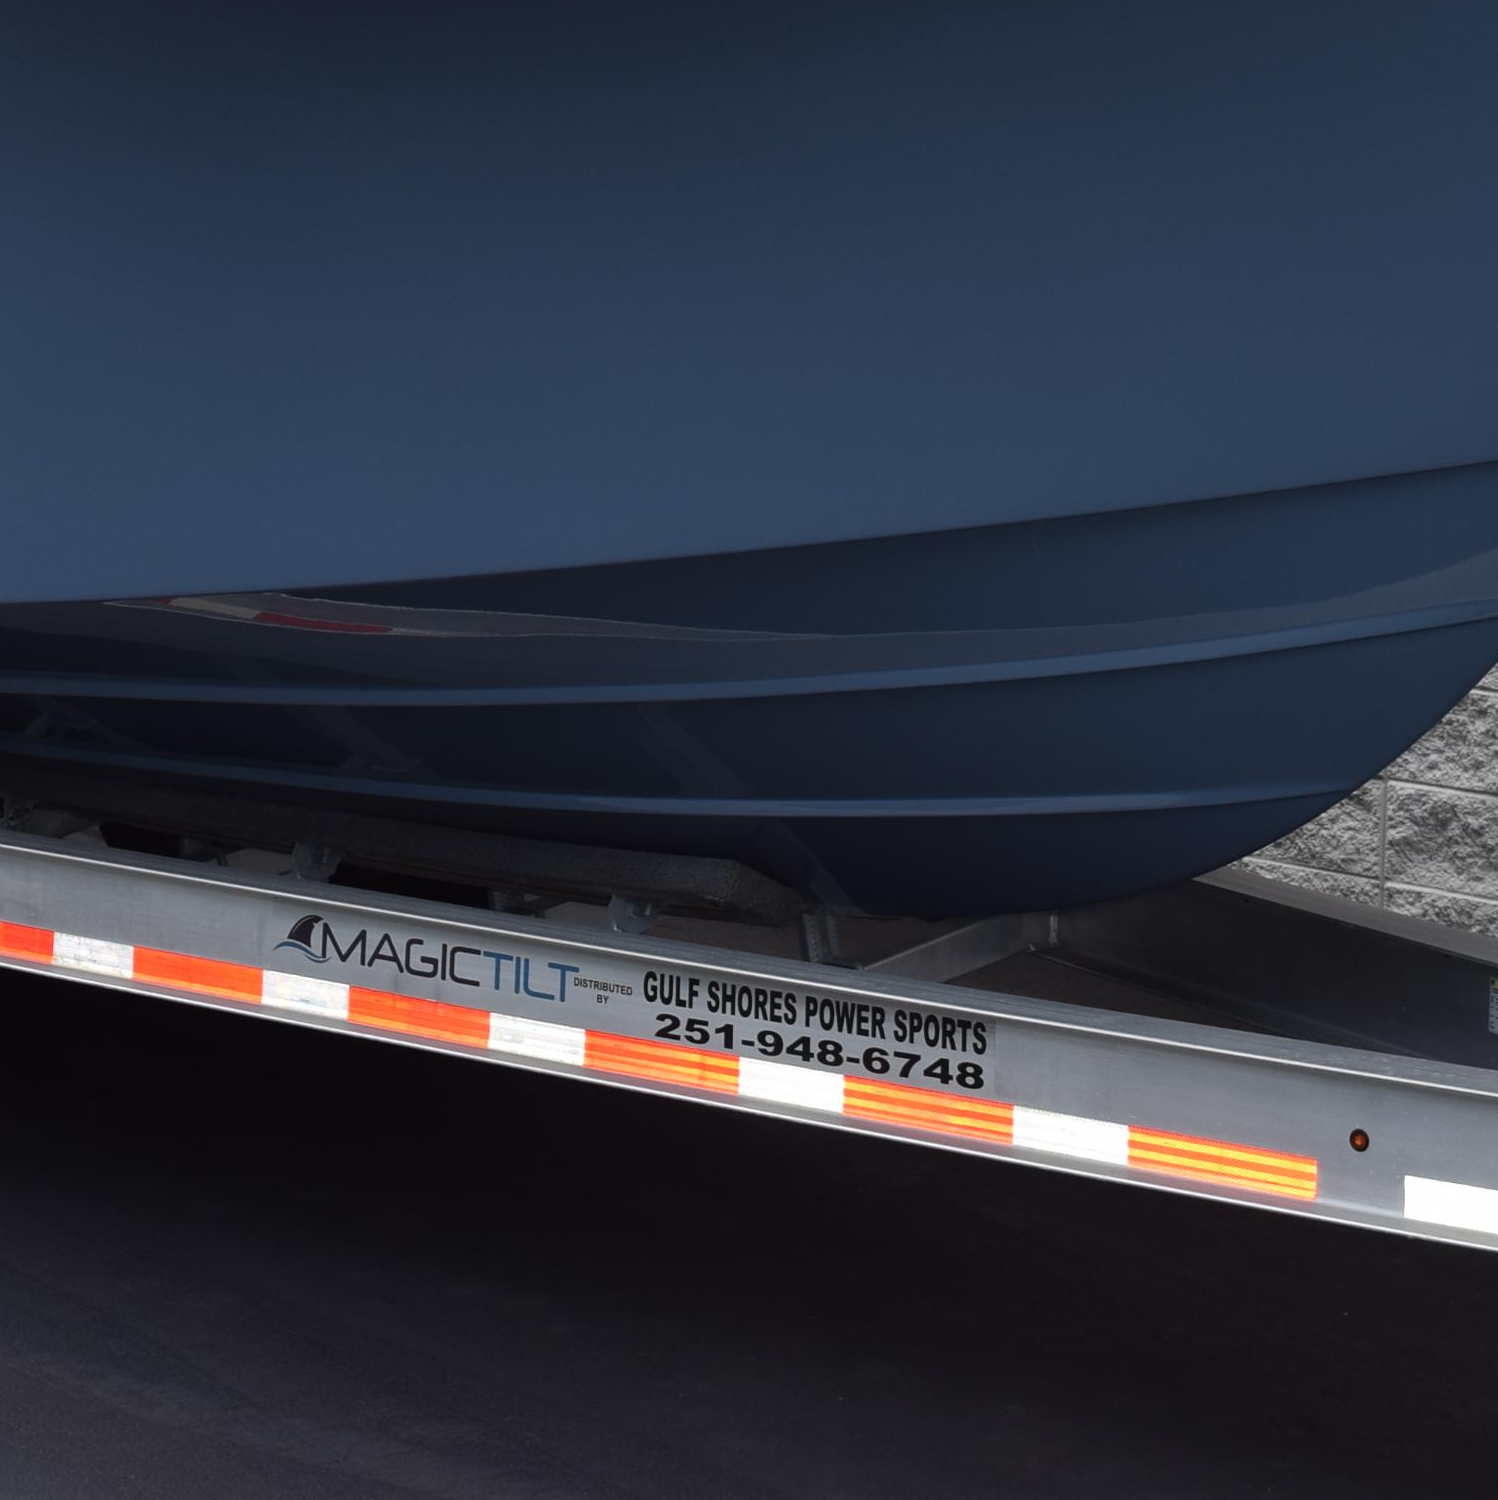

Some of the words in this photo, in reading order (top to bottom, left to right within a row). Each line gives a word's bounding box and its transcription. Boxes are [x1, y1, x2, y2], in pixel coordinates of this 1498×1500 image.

[322, 922, 579, 1002] MAGICTILT
[573, 976, 633, 996] DISTRIBUTED
[596, 994, 610, 1005] BY
[643, 970, 700, 1009] GULF
[707, 980, 797, 1026] SHORES
[804, 995, 886, 1040] POWER
[893, 1009, 987, 1056] SPORTS
[654, 1013, 985, 1090] 251-948-6748
